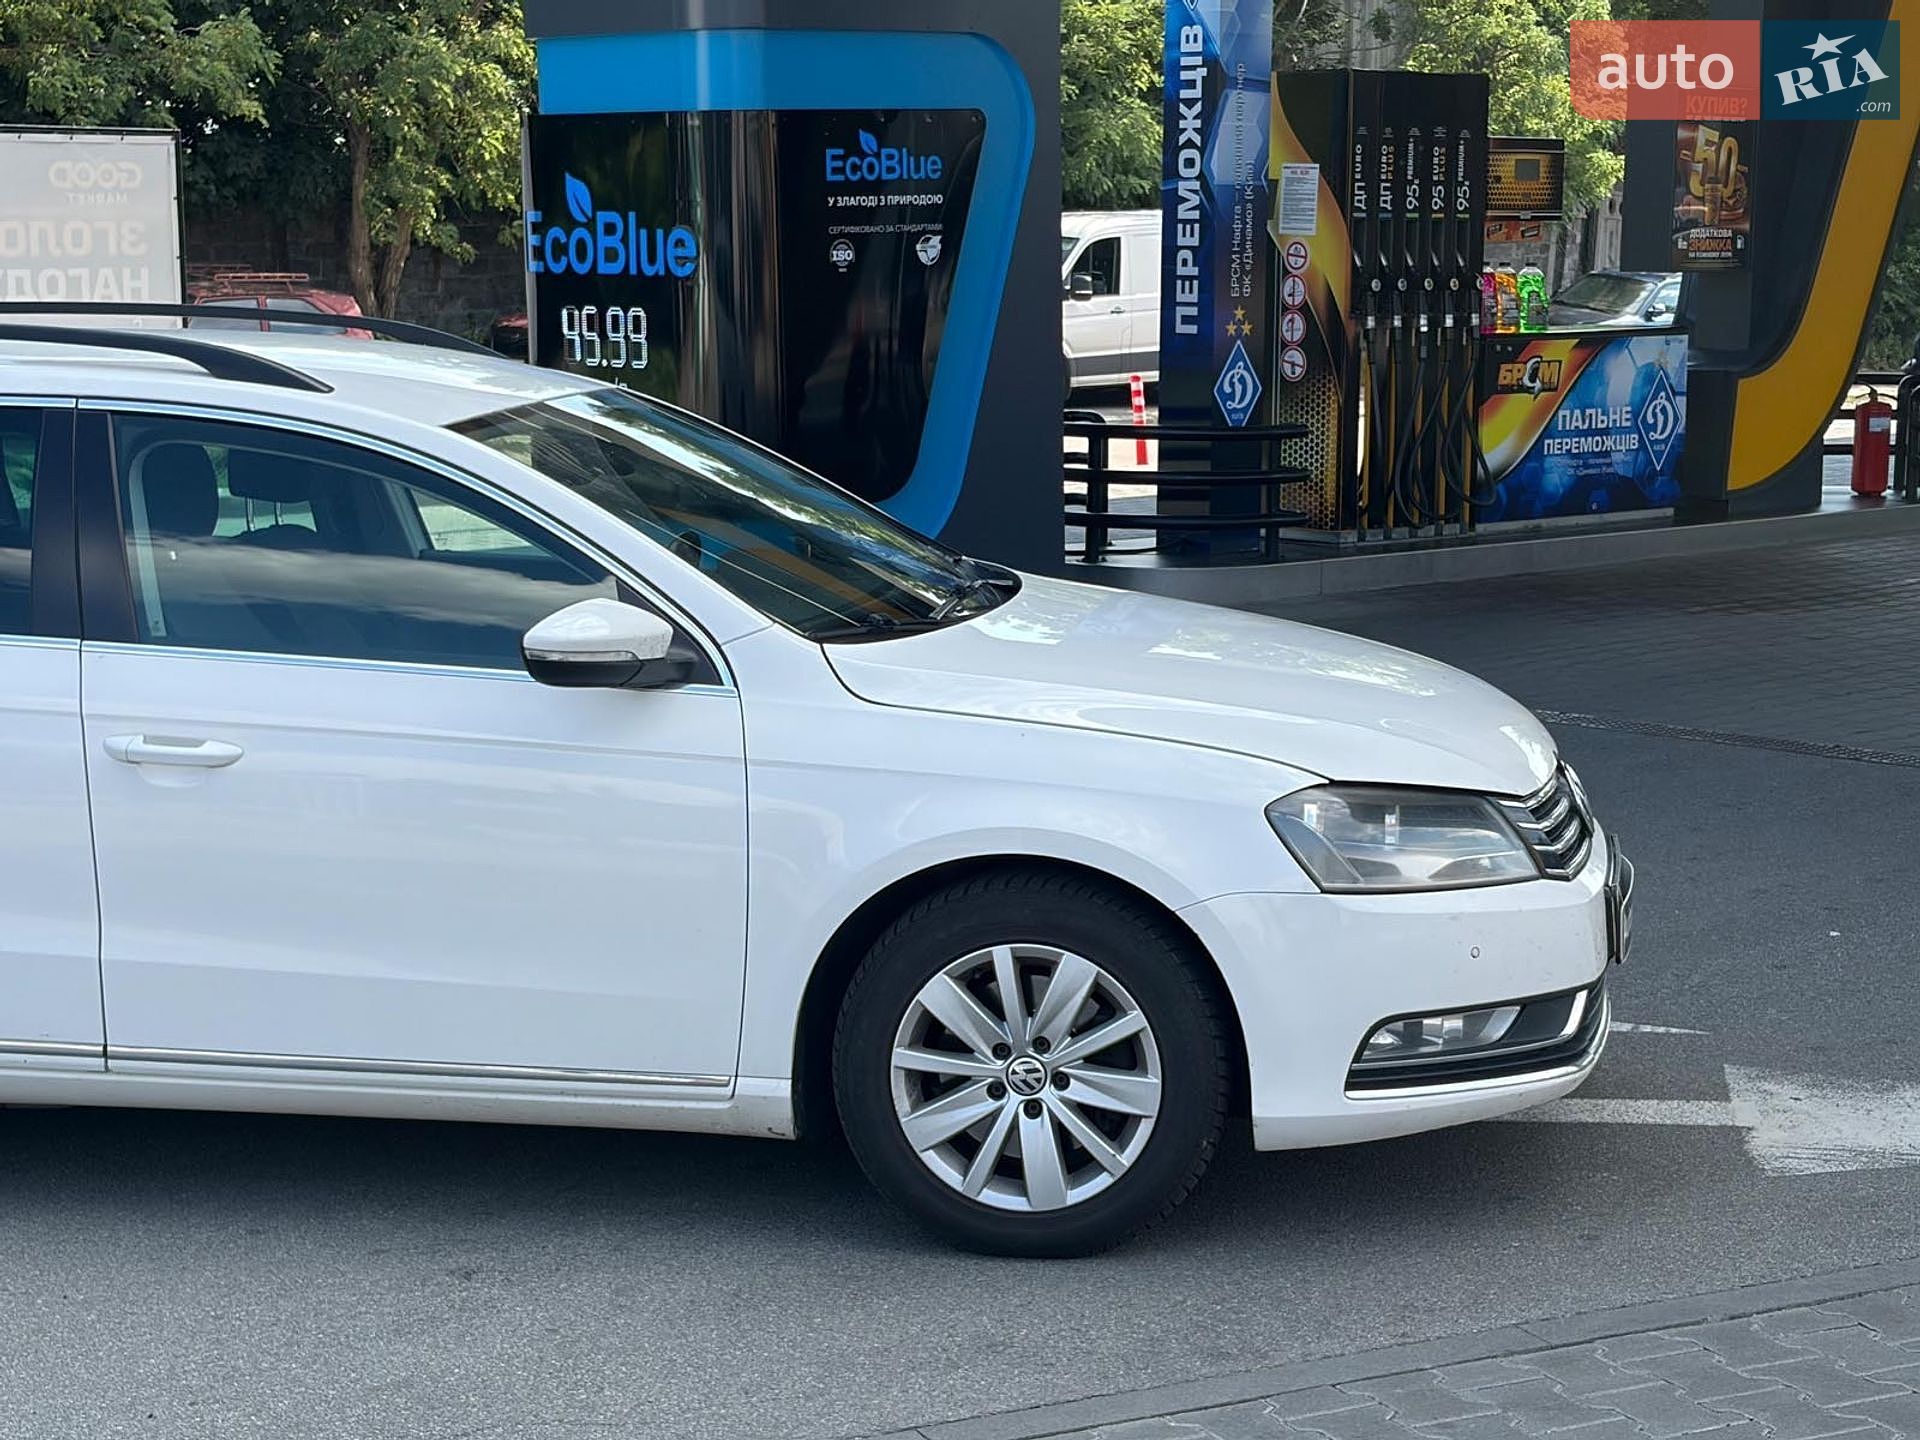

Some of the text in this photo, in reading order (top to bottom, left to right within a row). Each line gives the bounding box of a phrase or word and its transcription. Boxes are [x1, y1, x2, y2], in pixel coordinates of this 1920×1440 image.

[826, 147, 942, 181] EcoBlue
[1380, 145, 1388, 180] EURO
[1689, 124, 1739, 198] 50
[1175, 24, 1208, 334] ПЕРЕМОЖЦІВ
[827, 194, 944, 207] У ЗЛАГОДІ З ПРИРОДОЮ
[1354, 182, 1367, 210] ДП
[1380, 182, 1393, 210] ДП
[1431, 185, 1445, 210] 95
[1231, 206, 1242, 250] Нафта
[526, 210, 698, 278] EcoBlue
[832, 249, 854, 261] ISO
[1230, 254, 1240, 297] БРСМ
[1242, 273, 1252, 297] ФК
[561, 305, 648, 368] 45.99
[1557, 407, 1632, 431] ПАЛЬНЕ
[1543, 434, 1639, 455] ПЕРЕМОЖЦІВ
